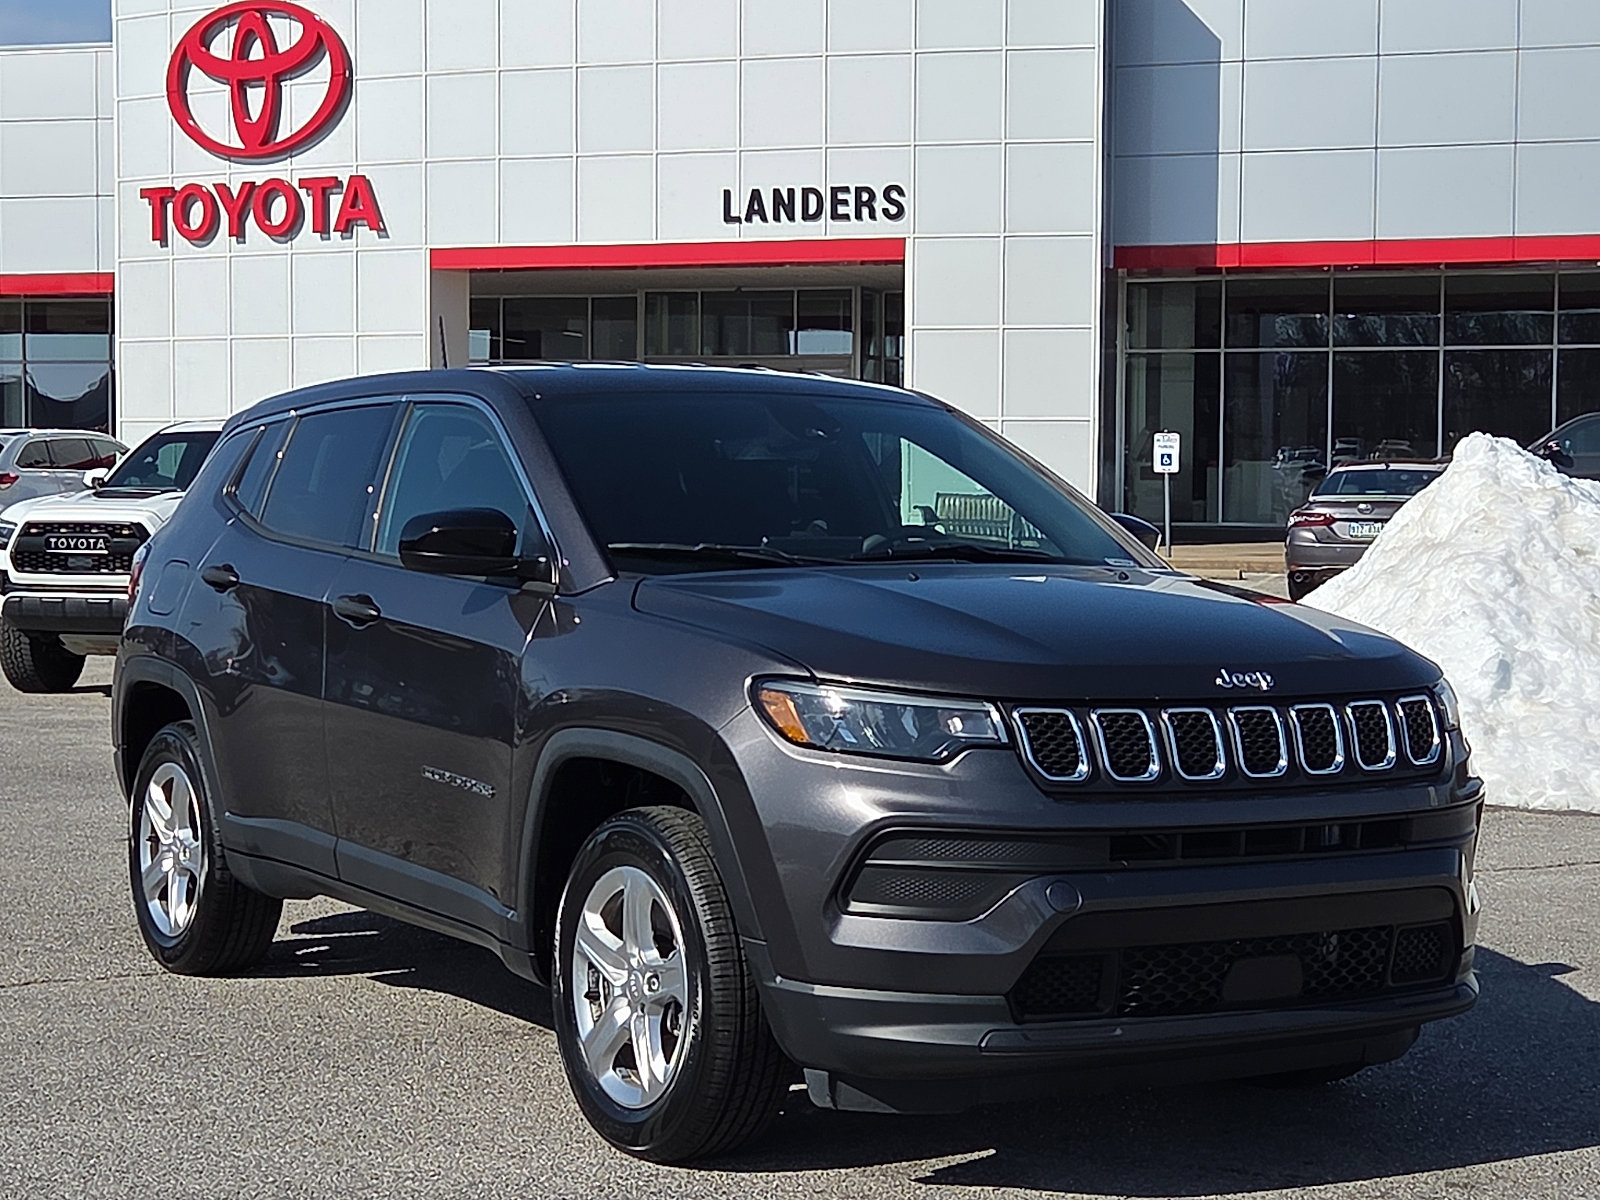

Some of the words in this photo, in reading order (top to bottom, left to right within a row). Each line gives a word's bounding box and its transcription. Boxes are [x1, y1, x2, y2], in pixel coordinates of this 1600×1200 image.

[140, 175, 386, 246] TOYOTA
[723, 184, 906, 223] LANDERS
[48, 537, 106, 550] TOYOTA
[1215, 668, 1275, 691] Jeep
